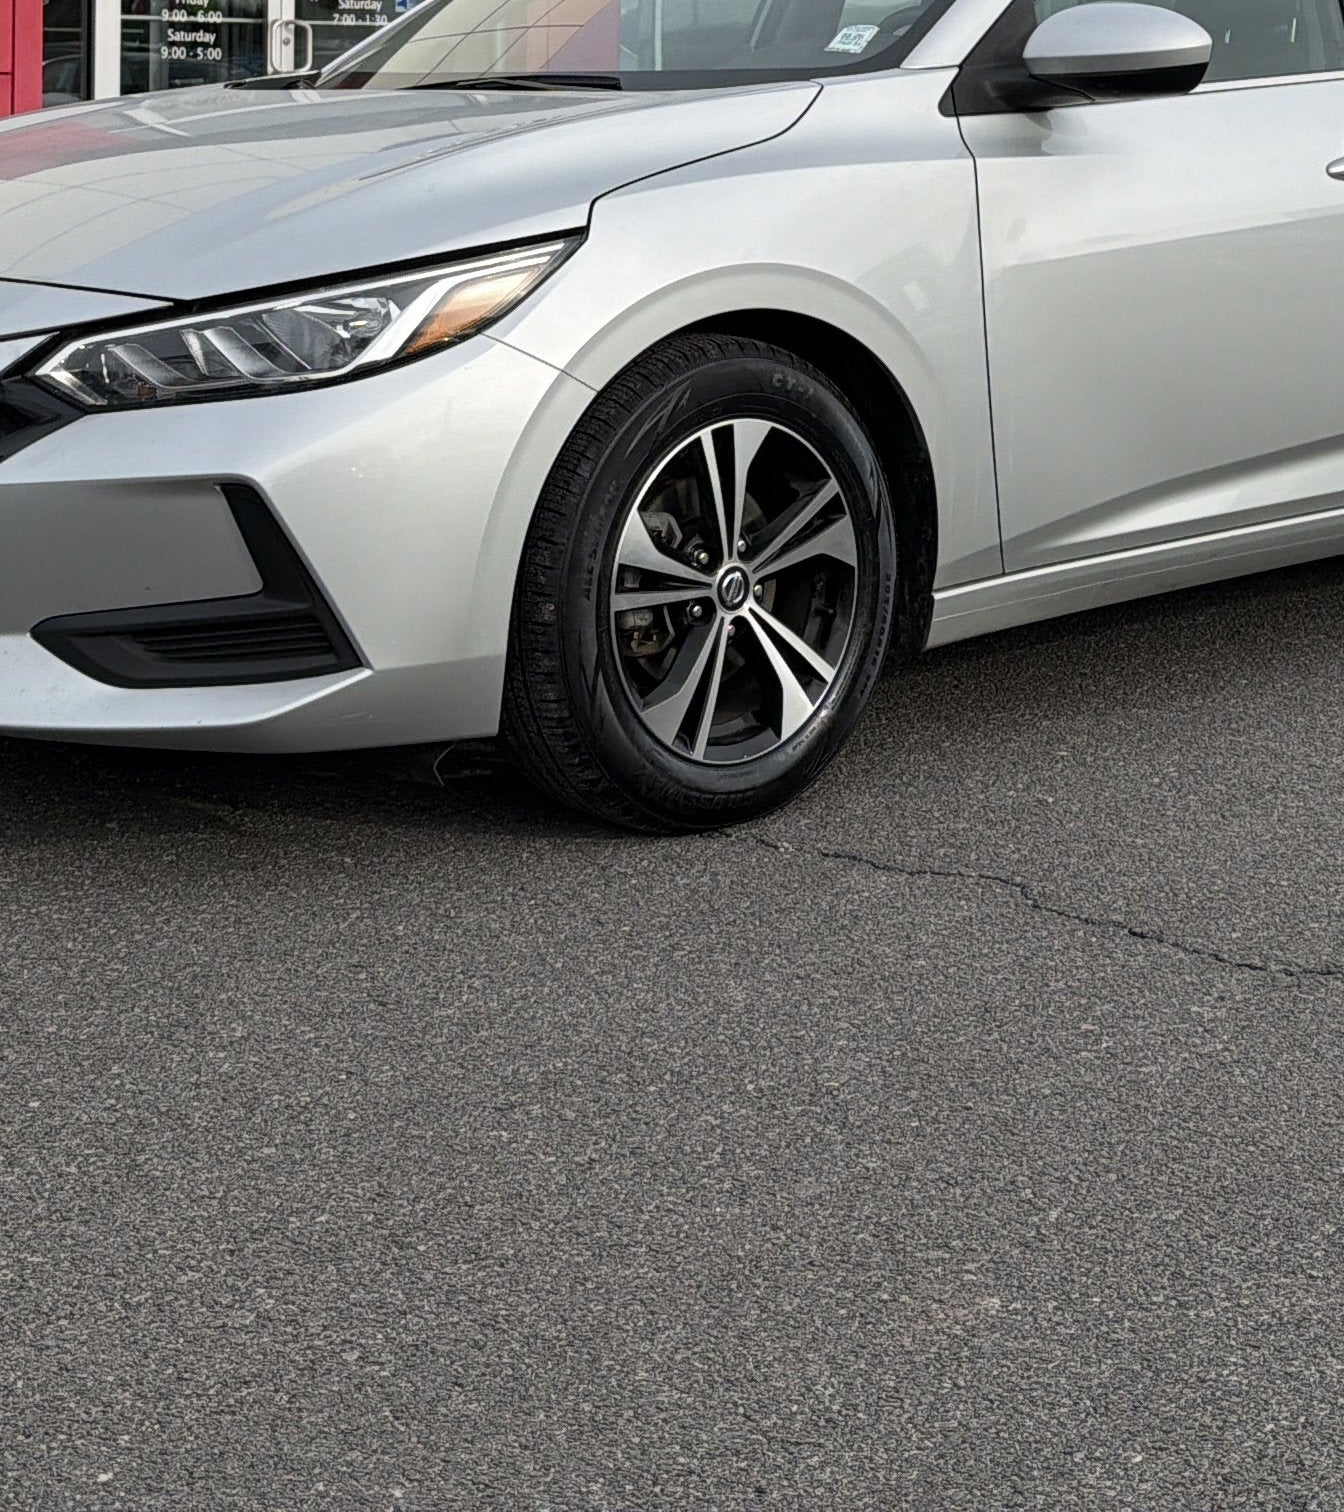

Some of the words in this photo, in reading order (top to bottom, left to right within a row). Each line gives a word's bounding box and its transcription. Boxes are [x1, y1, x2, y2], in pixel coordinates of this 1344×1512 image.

[161, 9, 187, 22] 9:00
[197, 10, 223, 23] 6:00
[332, 13, 355, 25] 7:00
[167, 28, 216, 45] Saturday
[161, 46, 186, 59] 9:00
[196, 47, 222, 60] 5:00
